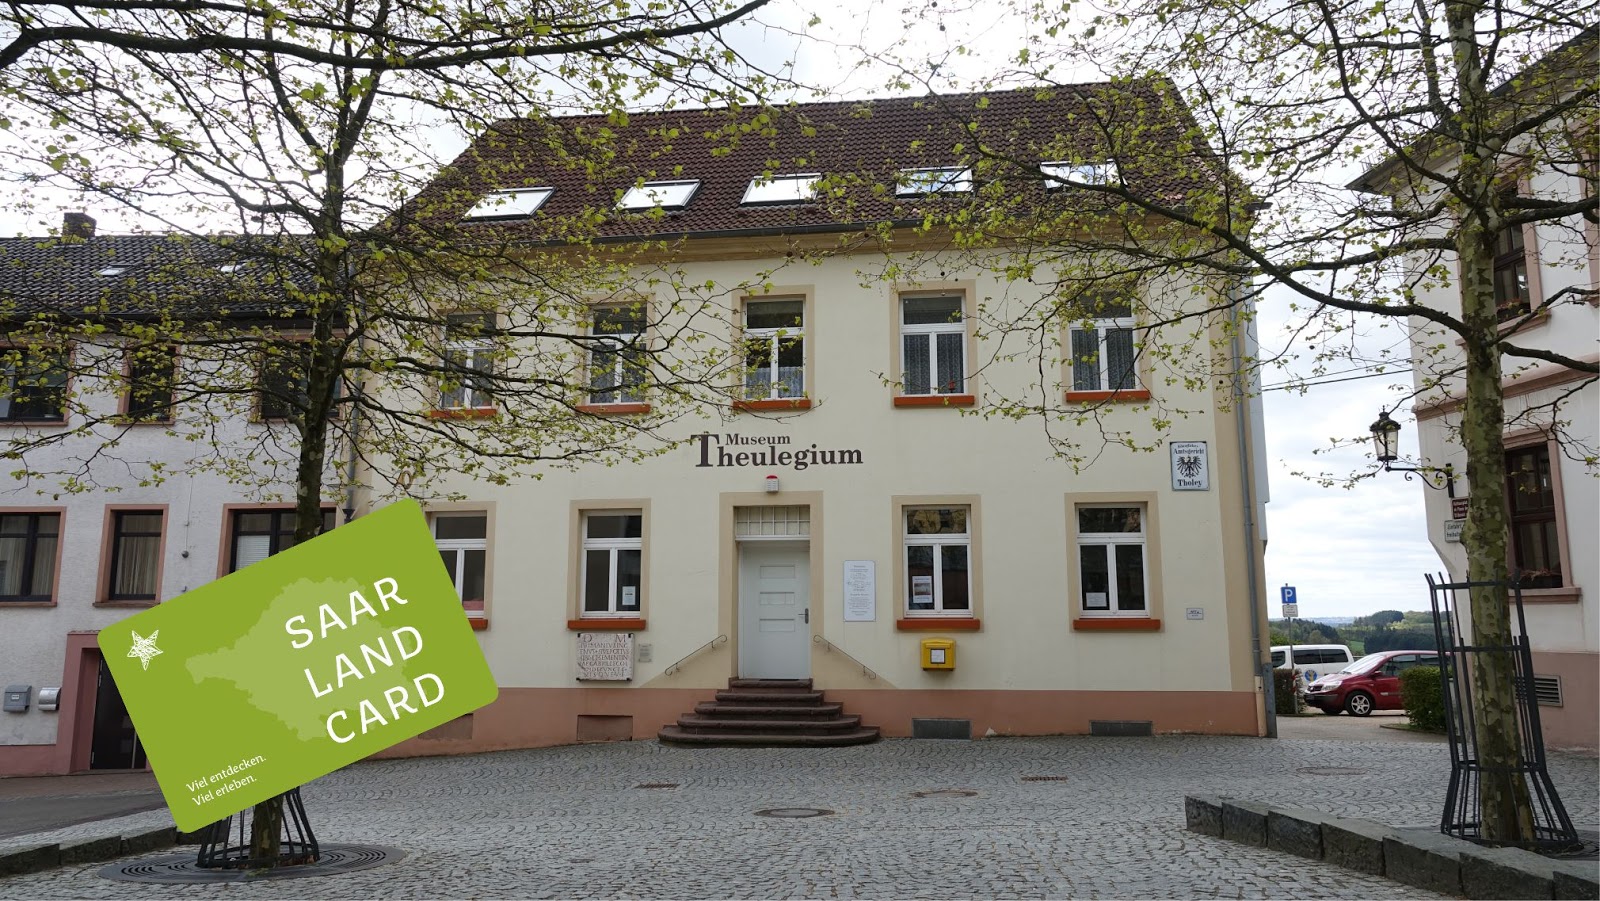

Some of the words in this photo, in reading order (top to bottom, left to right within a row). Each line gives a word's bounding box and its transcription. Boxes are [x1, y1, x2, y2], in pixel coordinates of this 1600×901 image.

[725, 433, 791, 445] Museum
[690, 434, 863, 470] Theulegium
[1177, 479, 1202, 487] Tholey
[1285, 589, 1293, 602] P
